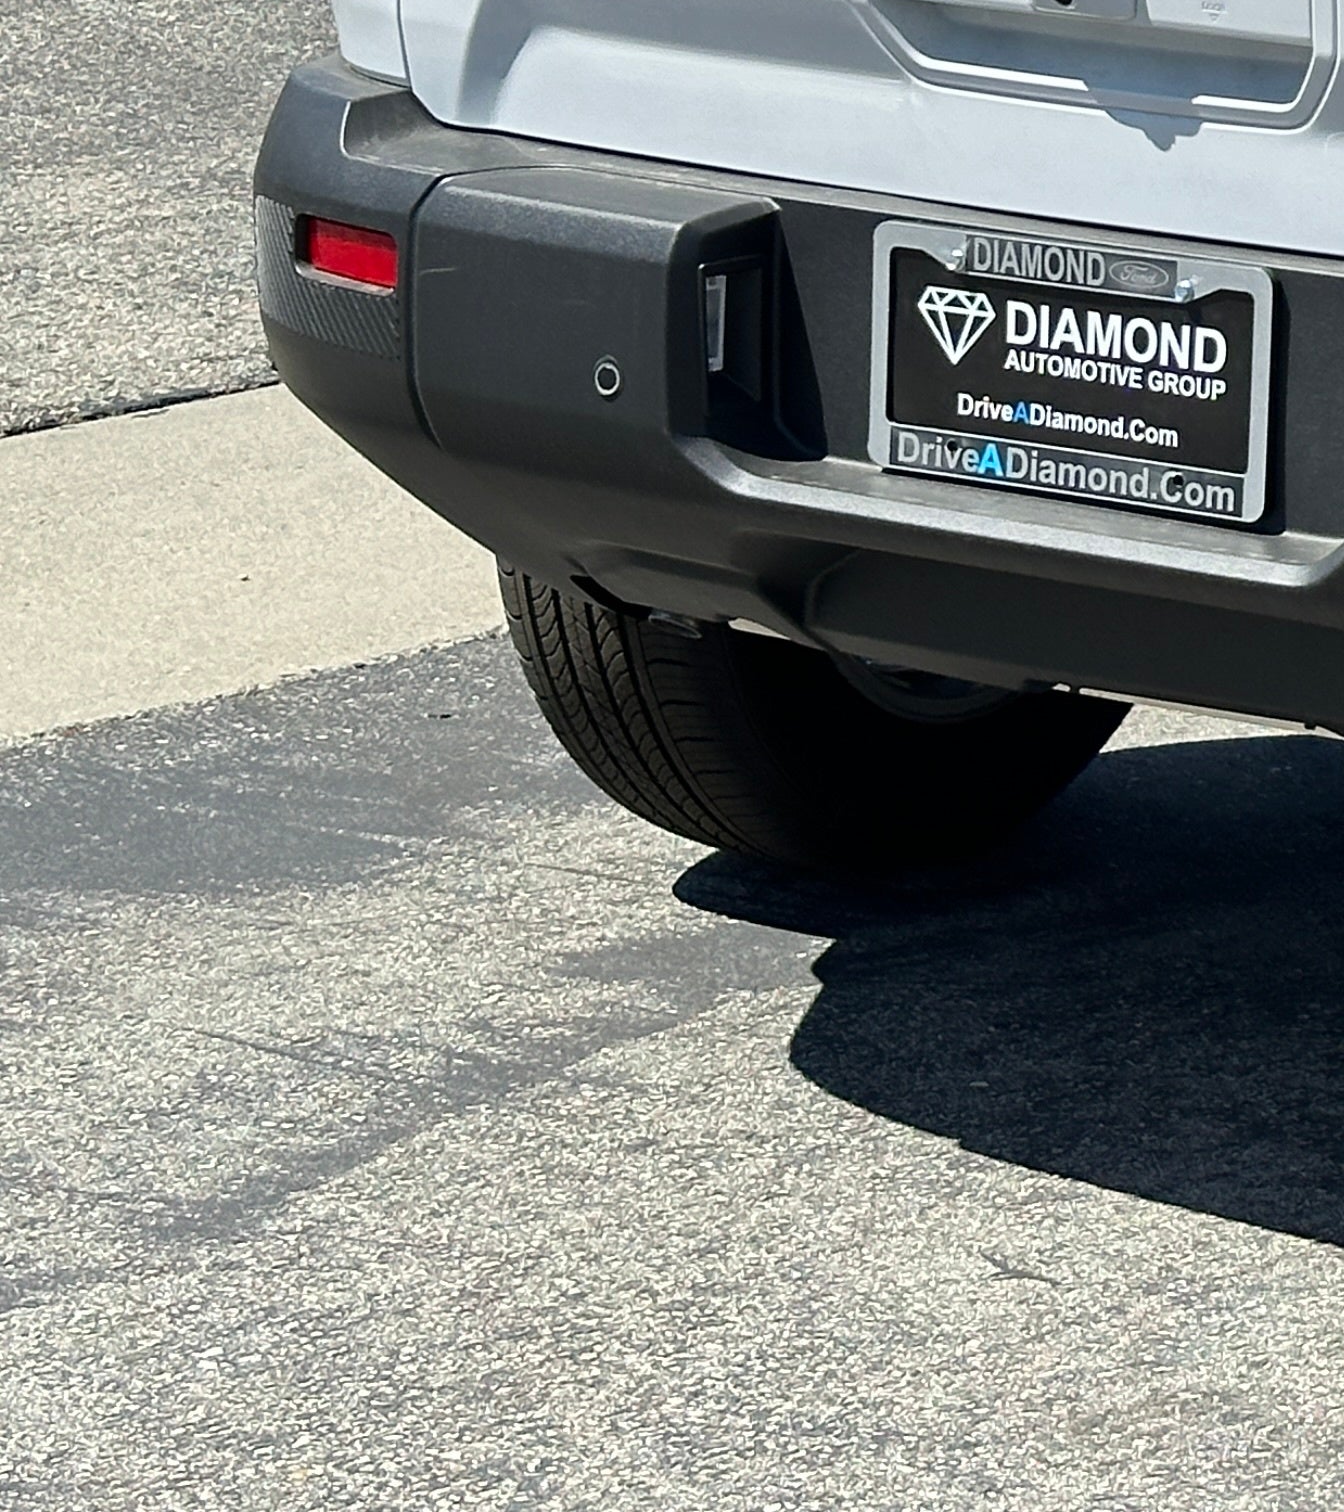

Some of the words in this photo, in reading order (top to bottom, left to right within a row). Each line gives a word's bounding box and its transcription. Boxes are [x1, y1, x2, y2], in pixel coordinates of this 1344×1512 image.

[971, 237, 1106, 286] DIAMOND
[1004, 299, 1228, 374] DIAMOND
[1003, 349, 1143, 390] AUTOMOTIVE
[1147, 369, 1227, 402] GROUP
[957, 392, 1180, 449] DriveADiamond.Com
[897, 431, 1236, 513] DriveADiamond.Com
